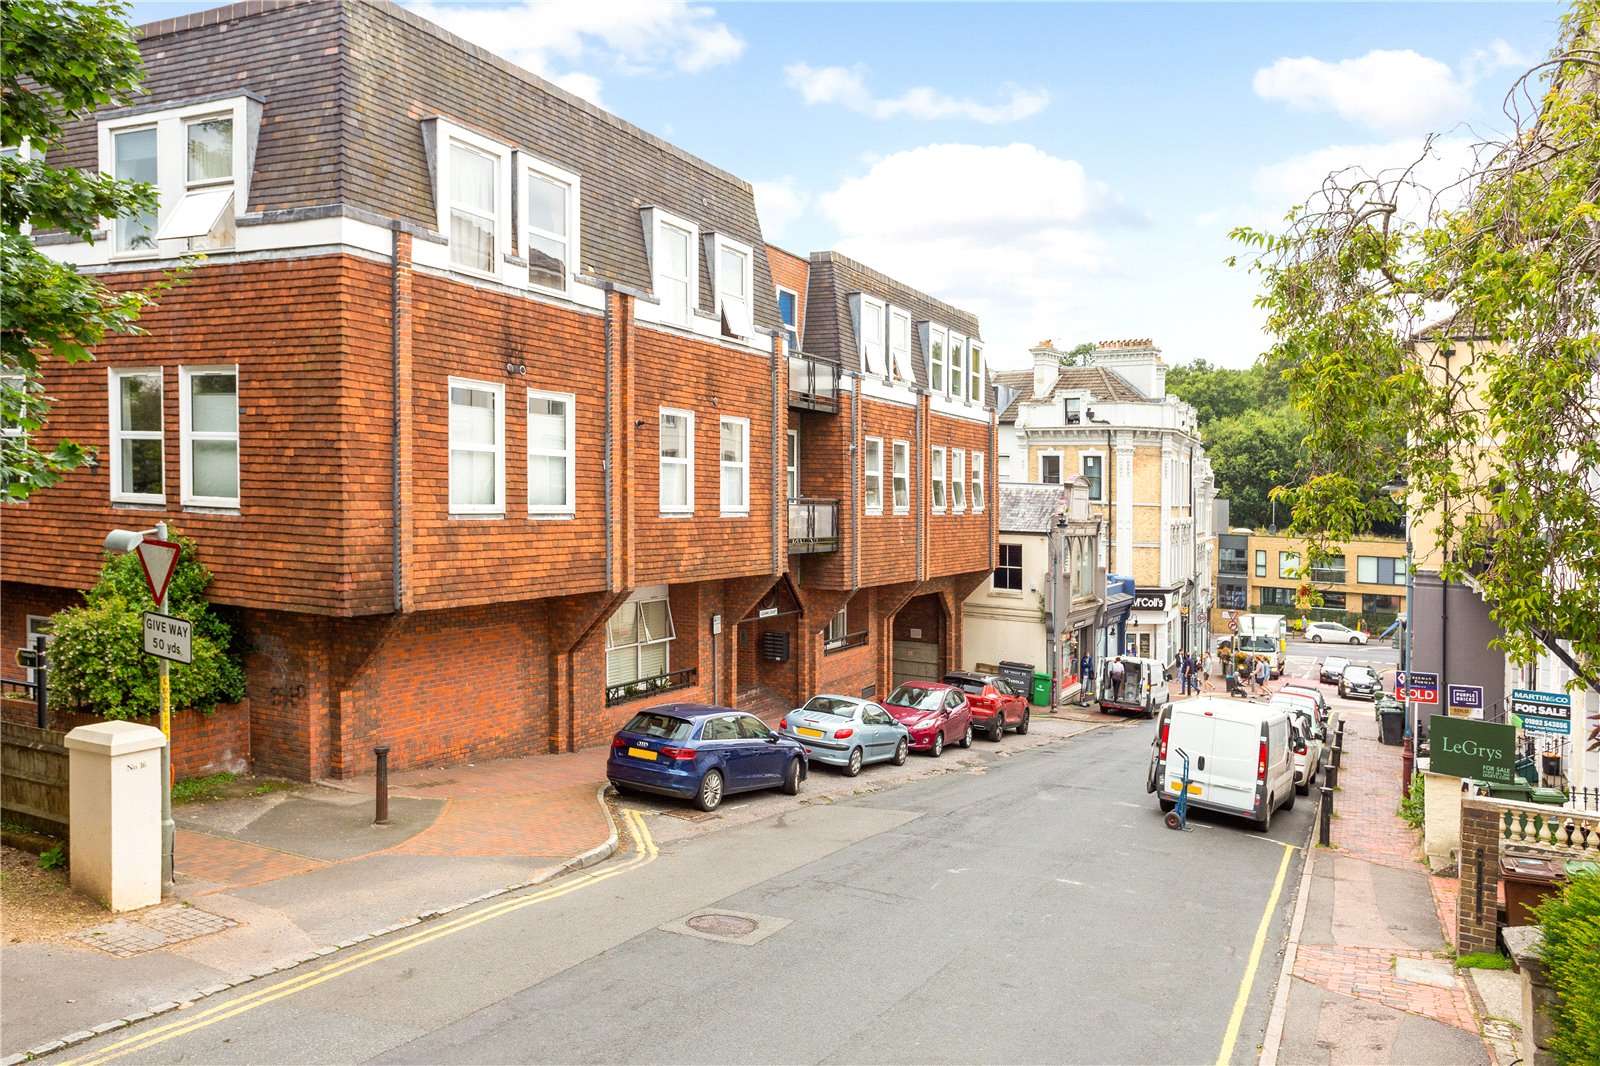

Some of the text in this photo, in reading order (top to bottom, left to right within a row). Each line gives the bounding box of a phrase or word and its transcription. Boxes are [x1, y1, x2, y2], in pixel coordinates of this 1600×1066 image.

[146, 618, 188, 638] GIVE WAY
[152, 637, 165, 650] 50
[1399, 688, 1434, 700] SOLD
[1514, 692, 1569, 703] MARTIN&CO
[1514, 703, 1567, 717] FOR SALE
[1442, 736, 1503, 762] LeGrys
